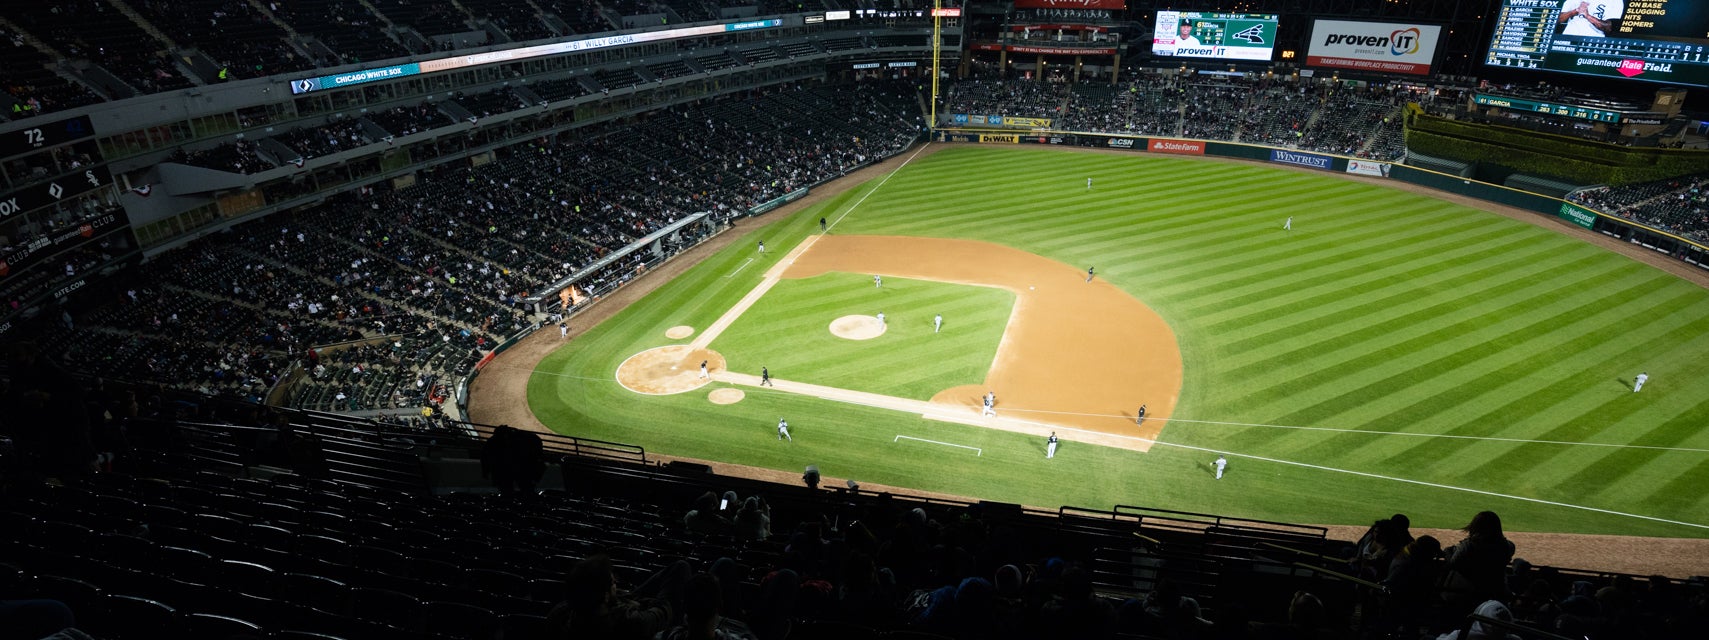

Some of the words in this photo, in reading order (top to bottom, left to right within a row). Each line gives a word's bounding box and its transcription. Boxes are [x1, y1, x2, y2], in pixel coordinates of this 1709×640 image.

[586, 39, 605, 48] WILLY
[609, 36, 634, 44] GARCIA
[1324, 34, 1388, 47] proven
[1397, 36, 1413, 48] IT
[1381, 63, 1415, 71] PRODUCTIVITY
[1577, 58, 1622, 68] guaranteed
[1622, 60, 1642, 70] Rate
[1643, 62, 1673, 72] Field.
[336, 74, 366, 84] CHICAGO
[367, 70, 388, 79] WHITE
[24, 128, 45, 144] 72
[0, 197, 20, 218] OX
[92, 214, 115, 229] CLUB
[1568, 208, 1595, 223] National
[7, 249, 29, 266] CLUB
[54, 280, 86, 299] RATE.COM
